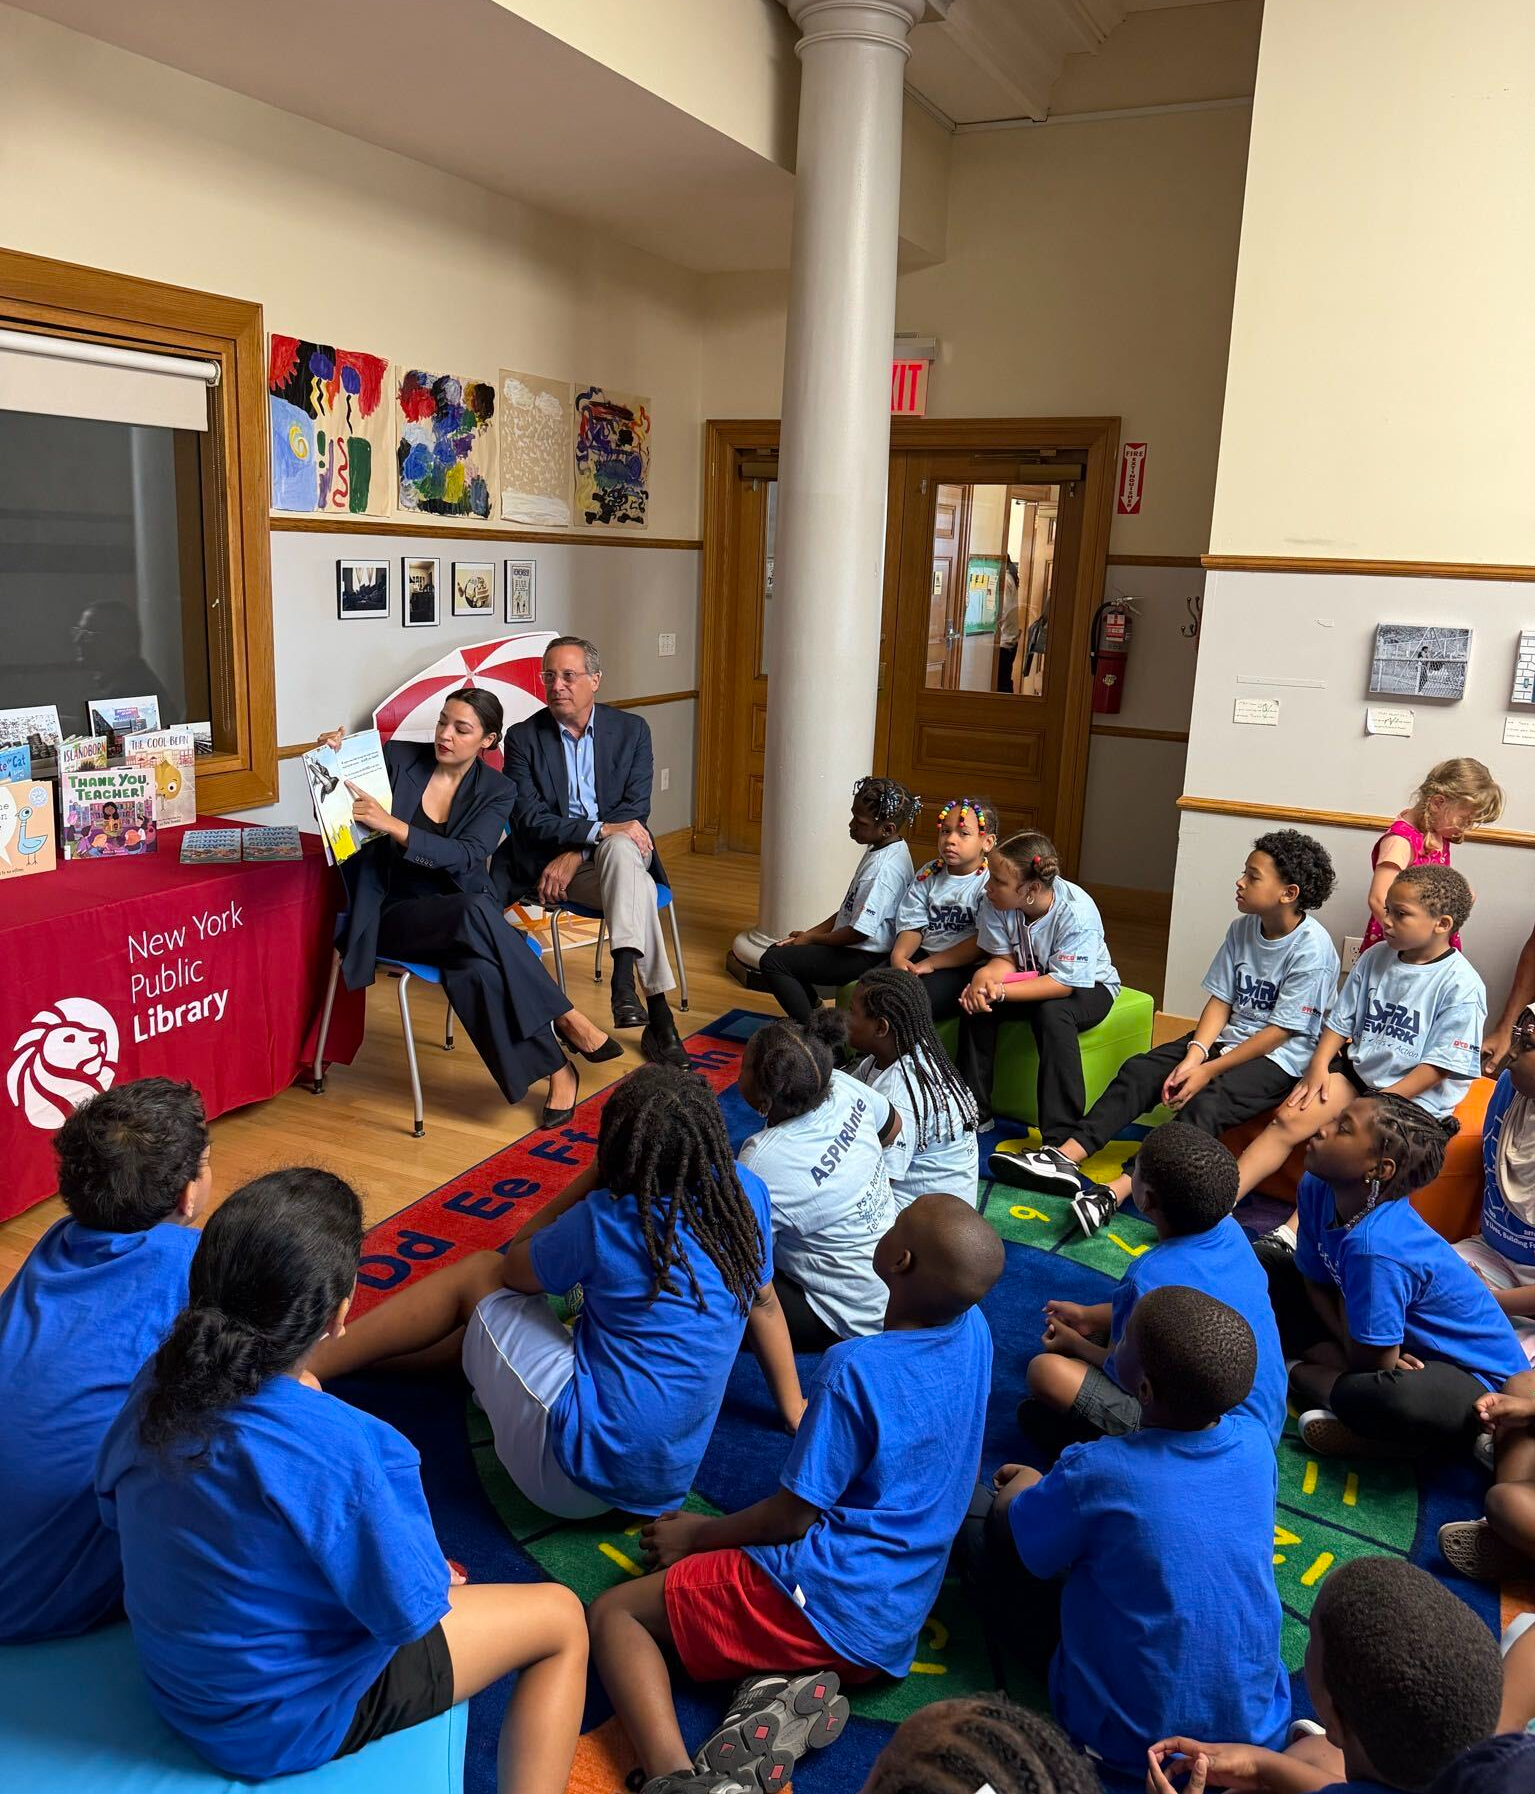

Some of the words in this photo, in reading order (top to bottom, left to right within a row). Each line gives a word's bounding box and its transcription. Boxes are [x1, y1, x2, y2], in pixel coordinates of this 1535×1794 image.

[891, 364, 922, 411] XIT
[1127, 457, 1138, 508] EXTINGUISHER
[12, 754, 26, 768] Cat
[63, 742, 106, 763] ISLANDBORN
[131, 739, 145, 751] THE
[147, 737, 167, 749] COOL
[169, 735, 189, 746] BEAN
[68, 776, 116, 788] THANK
[118, 773, 149, 787] YOU,
[75, 785, 145, 801] TEACHER!
[128, 926, 185, 964] New
[192, 900, 244, 940] York
[131, 957, 204, 1004] Public
[133, 988, 229, 1044] Library
[810, 1098, 867, 1187] ASPIRAnte
[442, 1178, 541, 1221] Ee
[856, 1197, 867, 1211] PS
